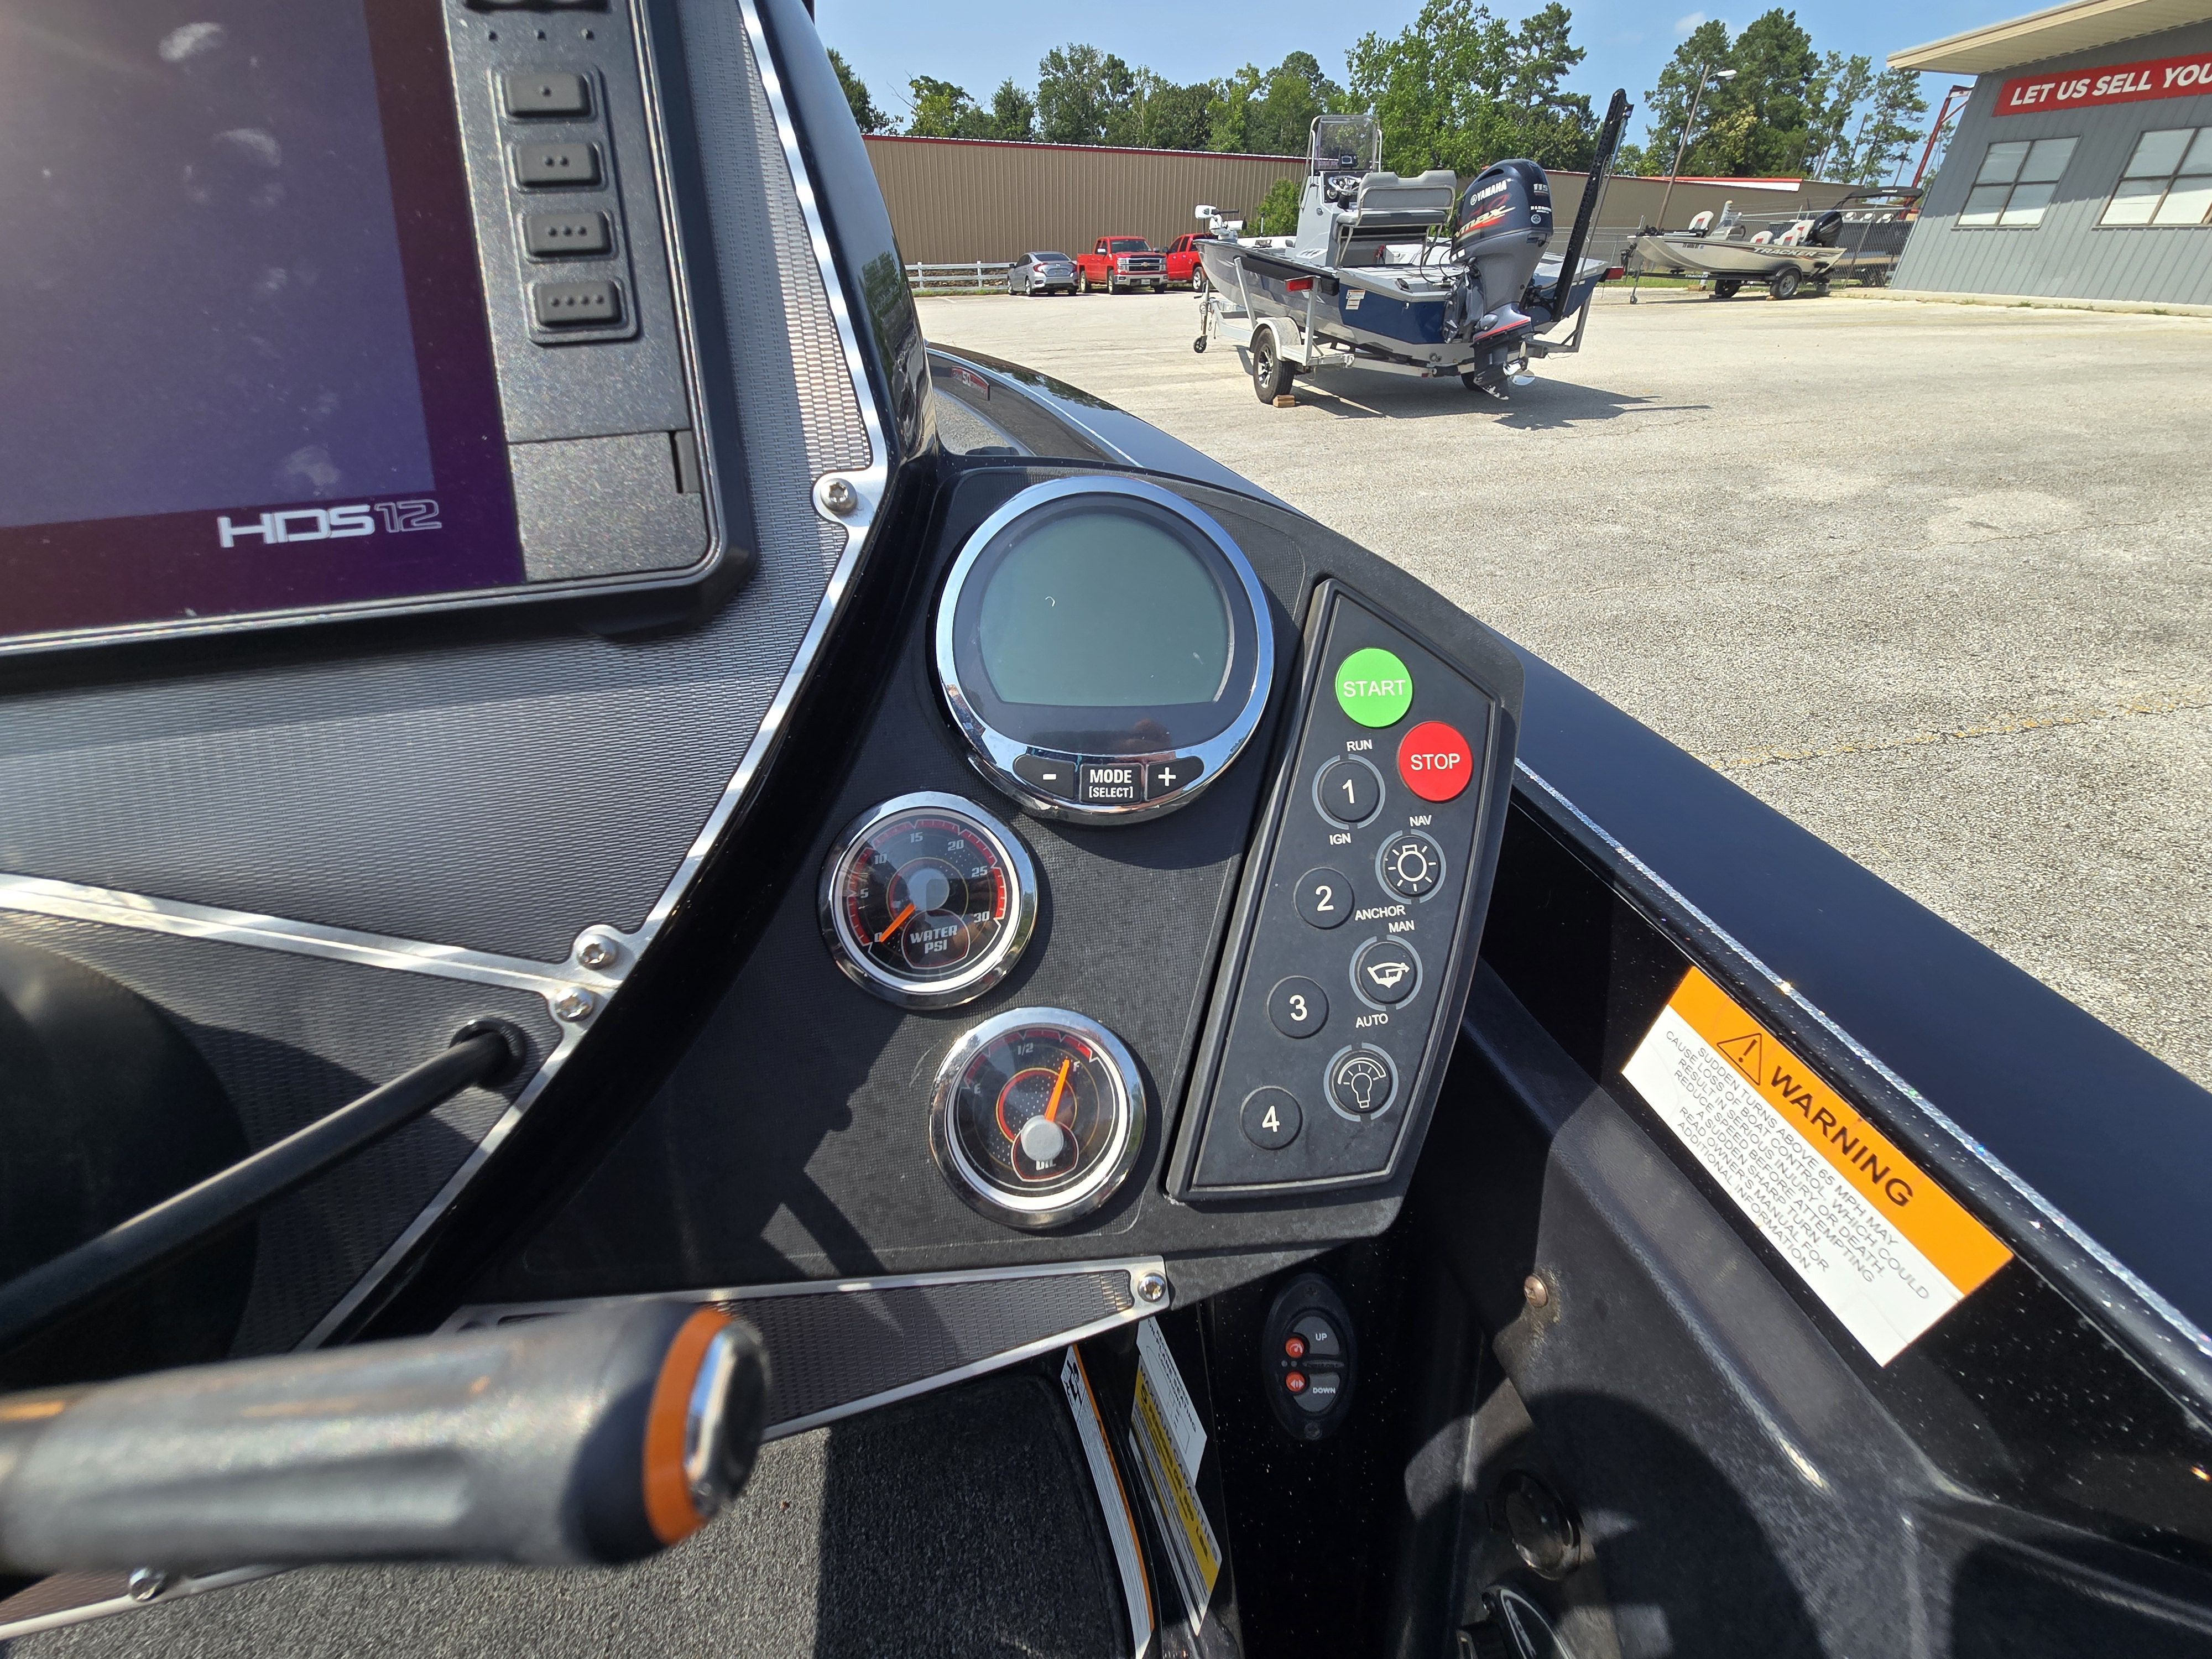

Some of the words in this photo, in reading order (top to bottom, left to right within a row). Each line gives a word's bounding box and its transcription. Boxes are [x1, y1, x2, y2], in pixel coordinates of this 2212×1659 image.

[2010, 84, 2054, 106] LET
[2057, 79, 2091, 100] US
[2092, 71, 2152, 96] SELL
[1477, 180, 1507, 201] YAMAHA
[1754, 247, 1817, 256] TRACKER
[1343, 679, 1406, 697] START
[1346, 739, 1373, 752] RUN
[1410, 754, 1460, 770] STOP
[1089, 769, 1132, 784] MODE
[1342, 779, 1355, 804] 1
[1409, 815, 1432, 826] NAV
[910, 832, 924, 843] 15
[947, 839, 964, 852] 20
[1329, 833, 1352, 845] IGN
[874, 854, 887, 864] 10
[971, 867, 988, 878] 25
[860, 888, 869, 898] 5
[1315, 885, 1334, 911] 2
[973, 911, 990, 923] 30
[1354, 905, 1406, 921] ANCHOR
[910, 925, 957, 944] WATER
[1388, 920, 1415, 933] MAN
[924, 940, 947, 954] PSI
[1289, 995, 1307, 1021] 3
[1355, 1013, 1389, 1029] AUTO
[1018, 1042, 1034, 1056] 1/2
[974, 1083, 981, 1094] E
[1262, 1105, 1280, 1133] 4
[1677, 1057, 1717, 1097] RESULT
[1714, 1095, 1728, 1111] IN
[1726, 1109, 1775, 1160] SERIOUS
[1773, 1158, 1819, 1202] INJURY
[1817, 1204, 1839, 1228] OR
[1771, 1066, 1912, 1206] WARNING
[1677, 1121, 1733, 1186] ADDITIONAL
[1697, 1047, 1740, 1091] SUDDEN
[1740, 1087, 1778, 1129] TURNS
[1775, 1128, 1820, 1170] ABOVE
[1818, 1168, 1836, 1186] 65
[1833, 1184, 1867, 1217] MPH
[1865, 1215, 1899, 1245] MAY
[1666, 1030, 1699, 1065] CAUSE
[1697, 1062, 1725, 1092] LOSS
[1724, 1091, 1742, 1106] OF
[1739, 1105, 1772, 1137] BOAT
[1832, 1198, 1878, 1248] WHICH
[1877, 1247, 1929, 1299] COULD
[1695, 1110, 1704, 1121] A
[1704, 1118, 1748, 1165] SUDDEN
[1746, 1164, 1786, 1204] SHARP
[1673, 1069, 1715, 1114] REDUCE
[1713, 1112, 1749, 1150] SPEED
[1747, 1148, 1796, 1200] BEFORE
[1792, 1199, 1875, 1282] ATTEMPTING
[1678, 1106, 1707, 1137] READ
[1706, 1136, 1754, 1190] OWNER'S
[1753, 1188, 1799, 1243] MANUAL
[1800, 1240, 1829, 1272] FOR
